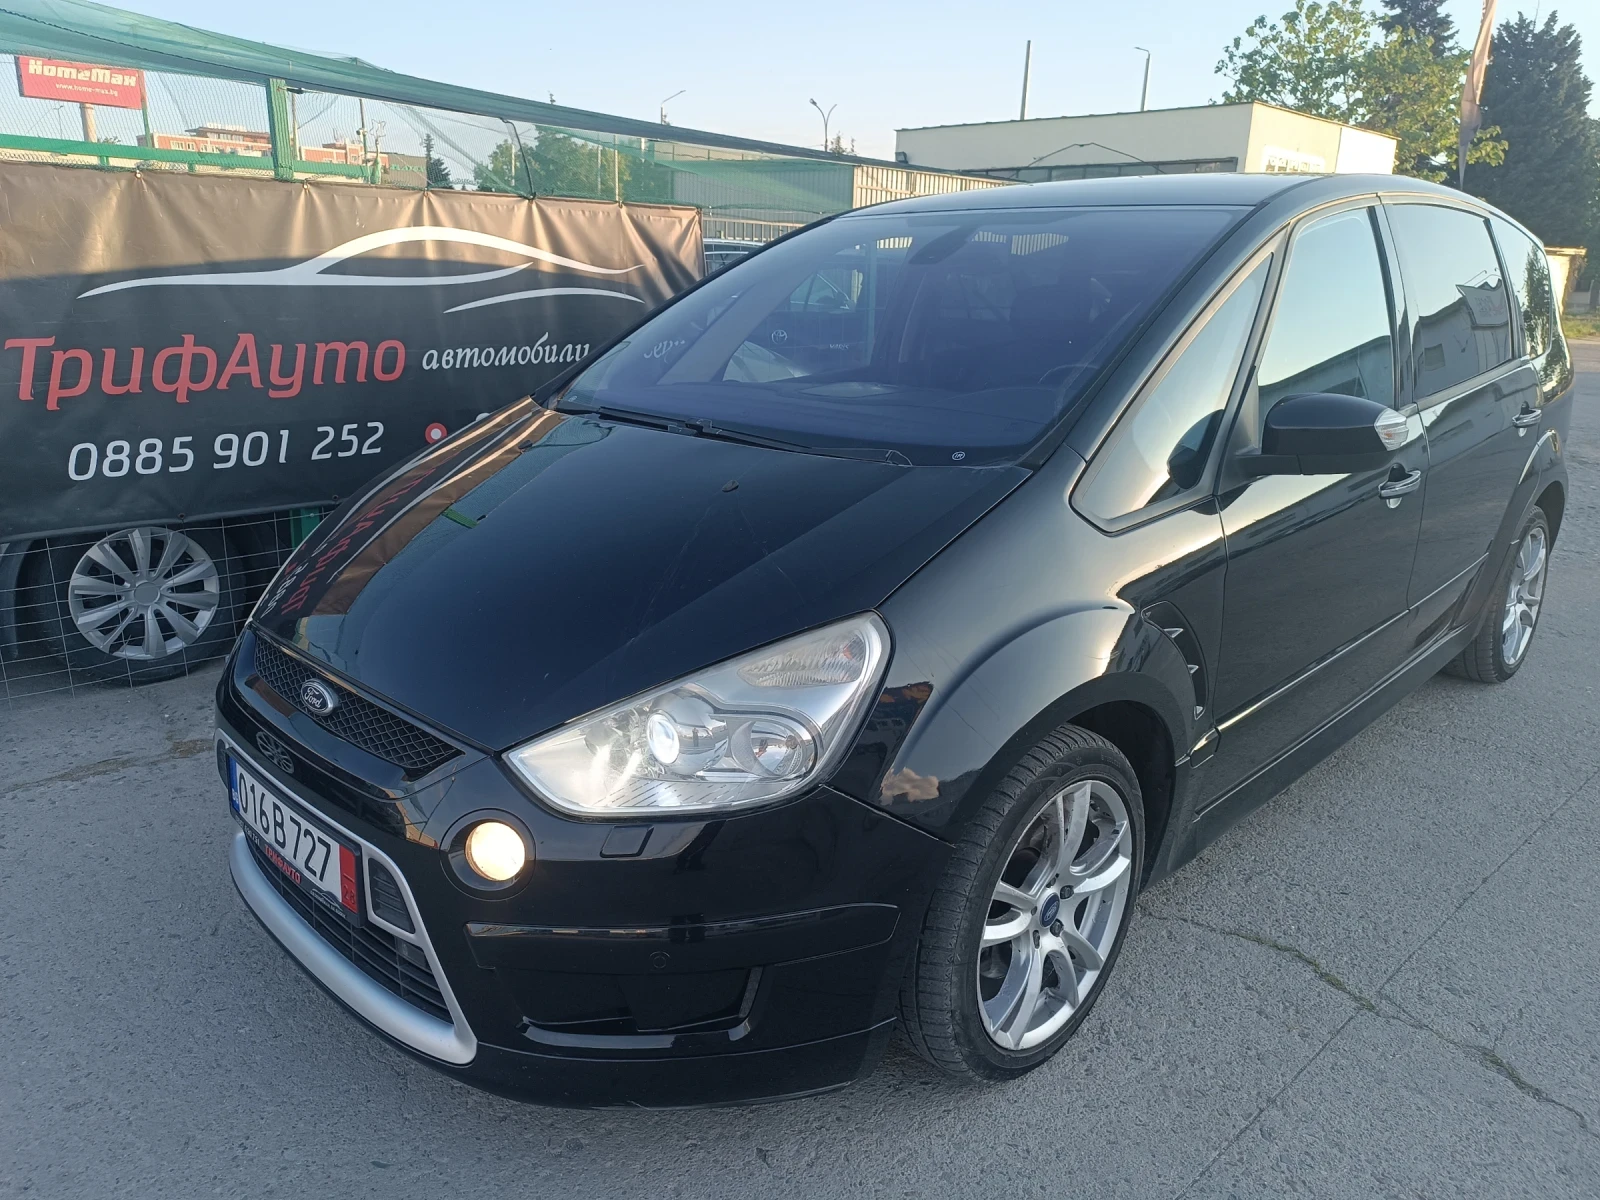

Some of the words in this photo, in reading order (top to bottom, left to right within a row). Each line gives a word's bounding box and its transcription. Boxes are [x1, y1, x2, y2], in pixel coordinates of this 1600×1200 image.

[28, 59, 137, 87] HomeMax
[4, 333, 406, 411] ТрифАуто
[67, 434, 195, 481] 0885
[212, 430, 288, 469] 901
[311, 421, 384, 461] 252
[303, 686, 322, 709] Ford
